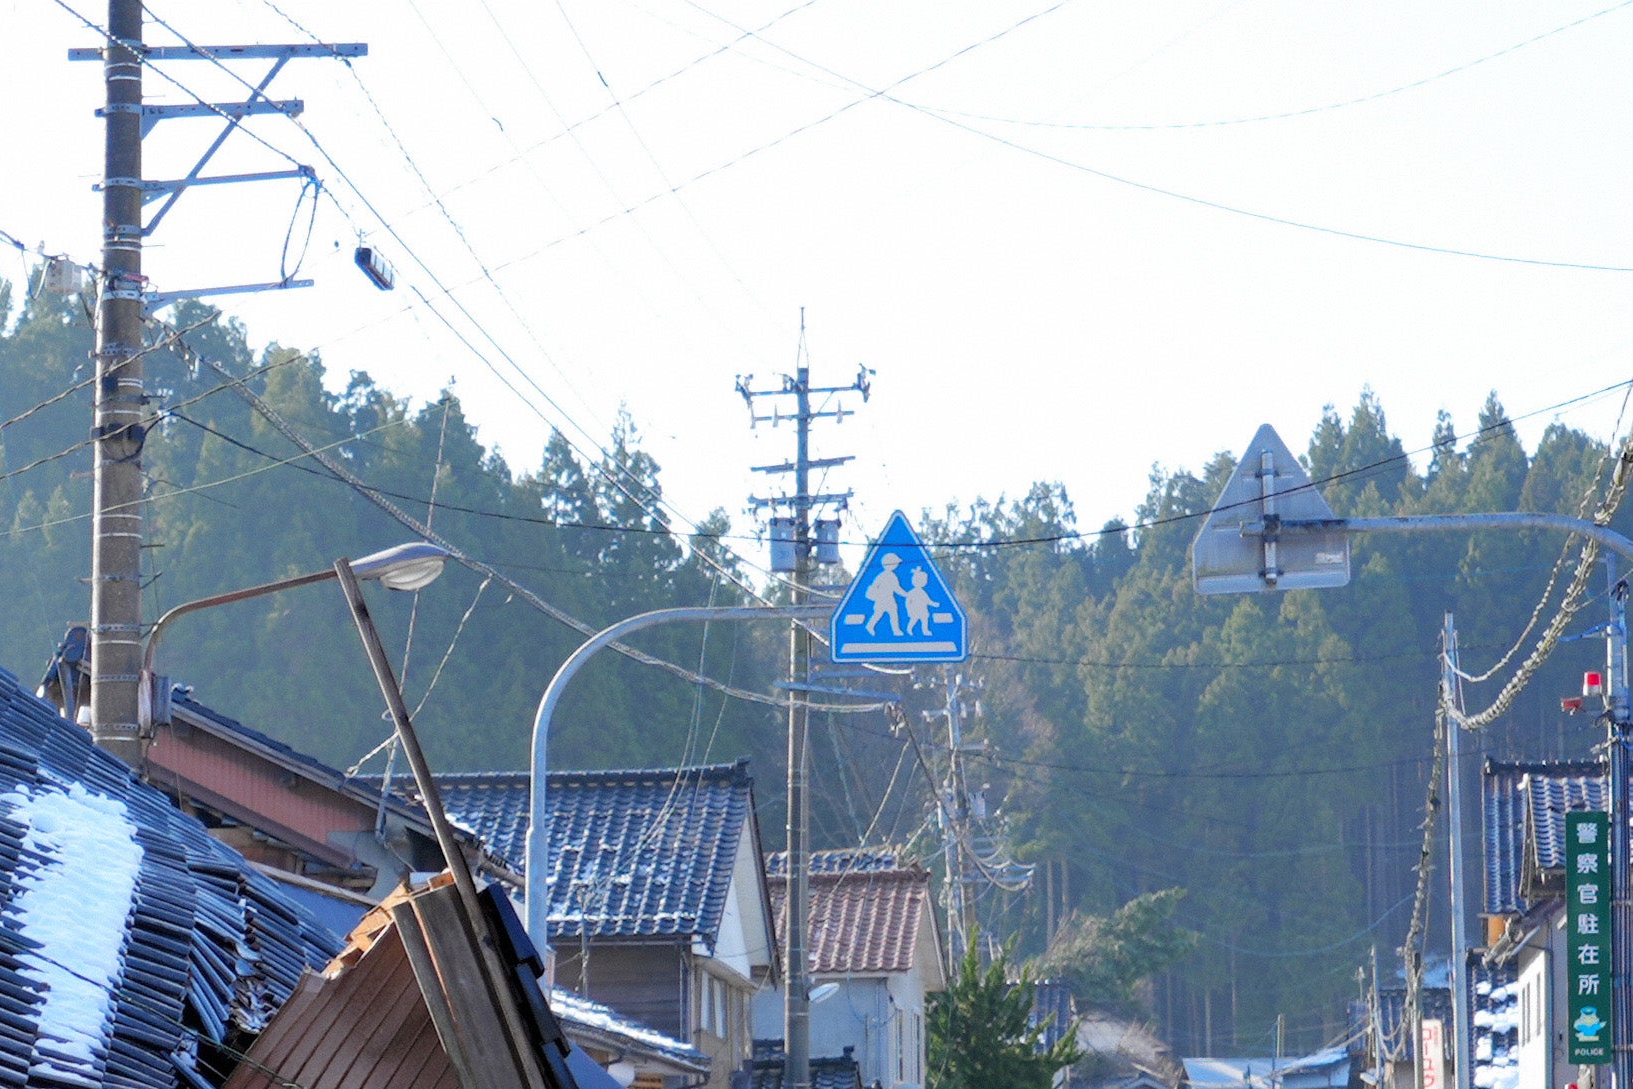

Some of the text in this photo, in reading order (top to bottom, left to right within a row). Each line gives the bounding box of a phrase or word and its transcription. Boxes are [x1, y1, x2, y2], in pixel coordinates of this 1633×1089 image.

[1576, 822, 1600, 995] 警察官駐在所
